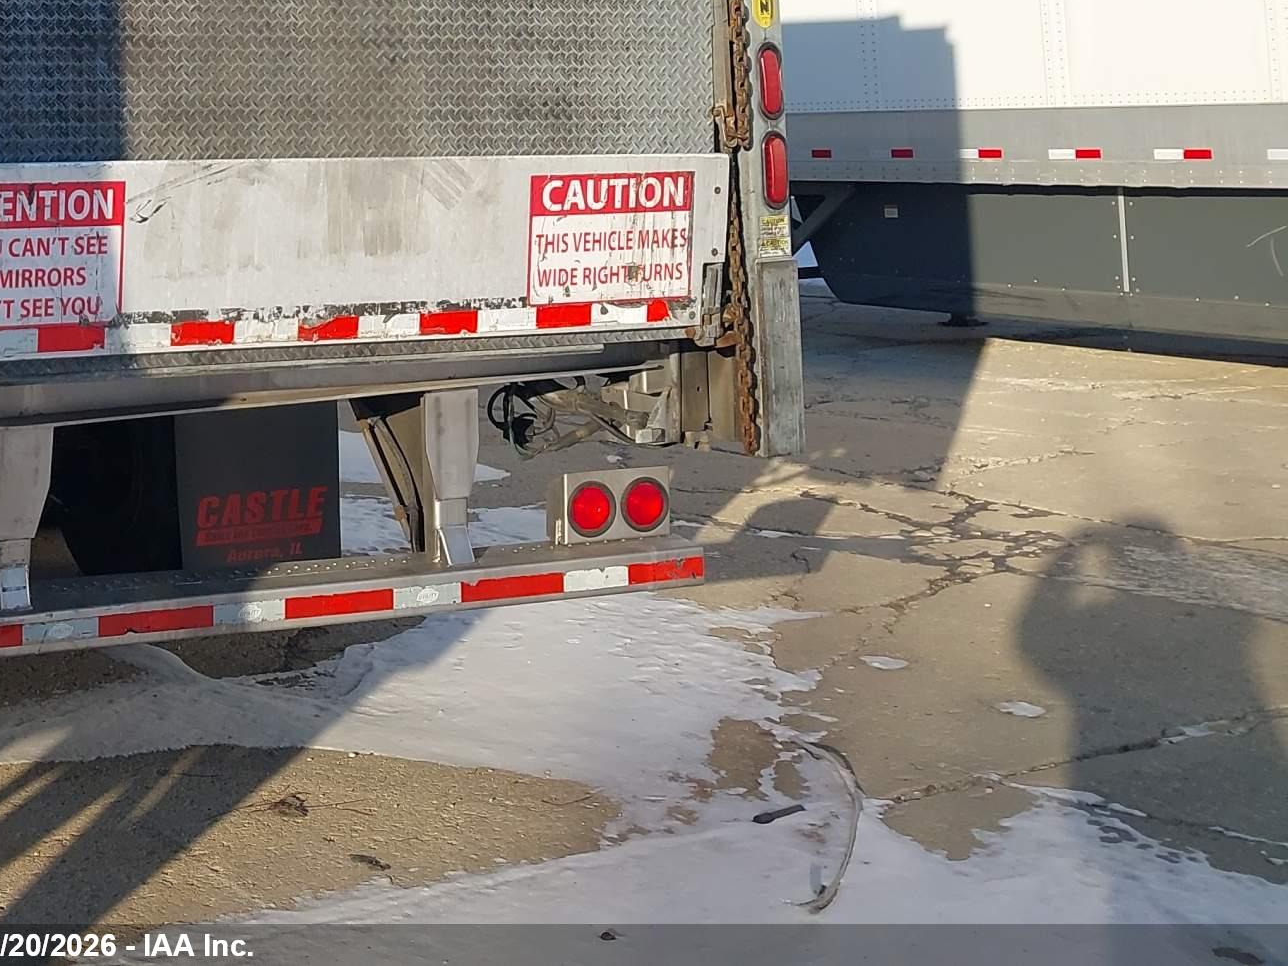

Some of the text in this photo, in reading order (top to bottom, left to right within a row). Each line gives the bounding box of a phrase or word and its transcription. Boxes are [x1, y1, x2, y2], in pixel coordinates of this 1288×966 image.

[542, 177, 685, 212] CAUTION
[8, 237, 69, 257] CAN'T
[74, 236, 108, 255] SEE
[536, 228, 688, 253] THIS VEHICLE MAKES
[537, 268, 579, 287] WIDE
[583, 265, 628, 285] RIGHT
[20, 298, 54, 317] SEE
[57, 296, 101, 315] YOU
[196, 487, 328, 528] CASTLE
